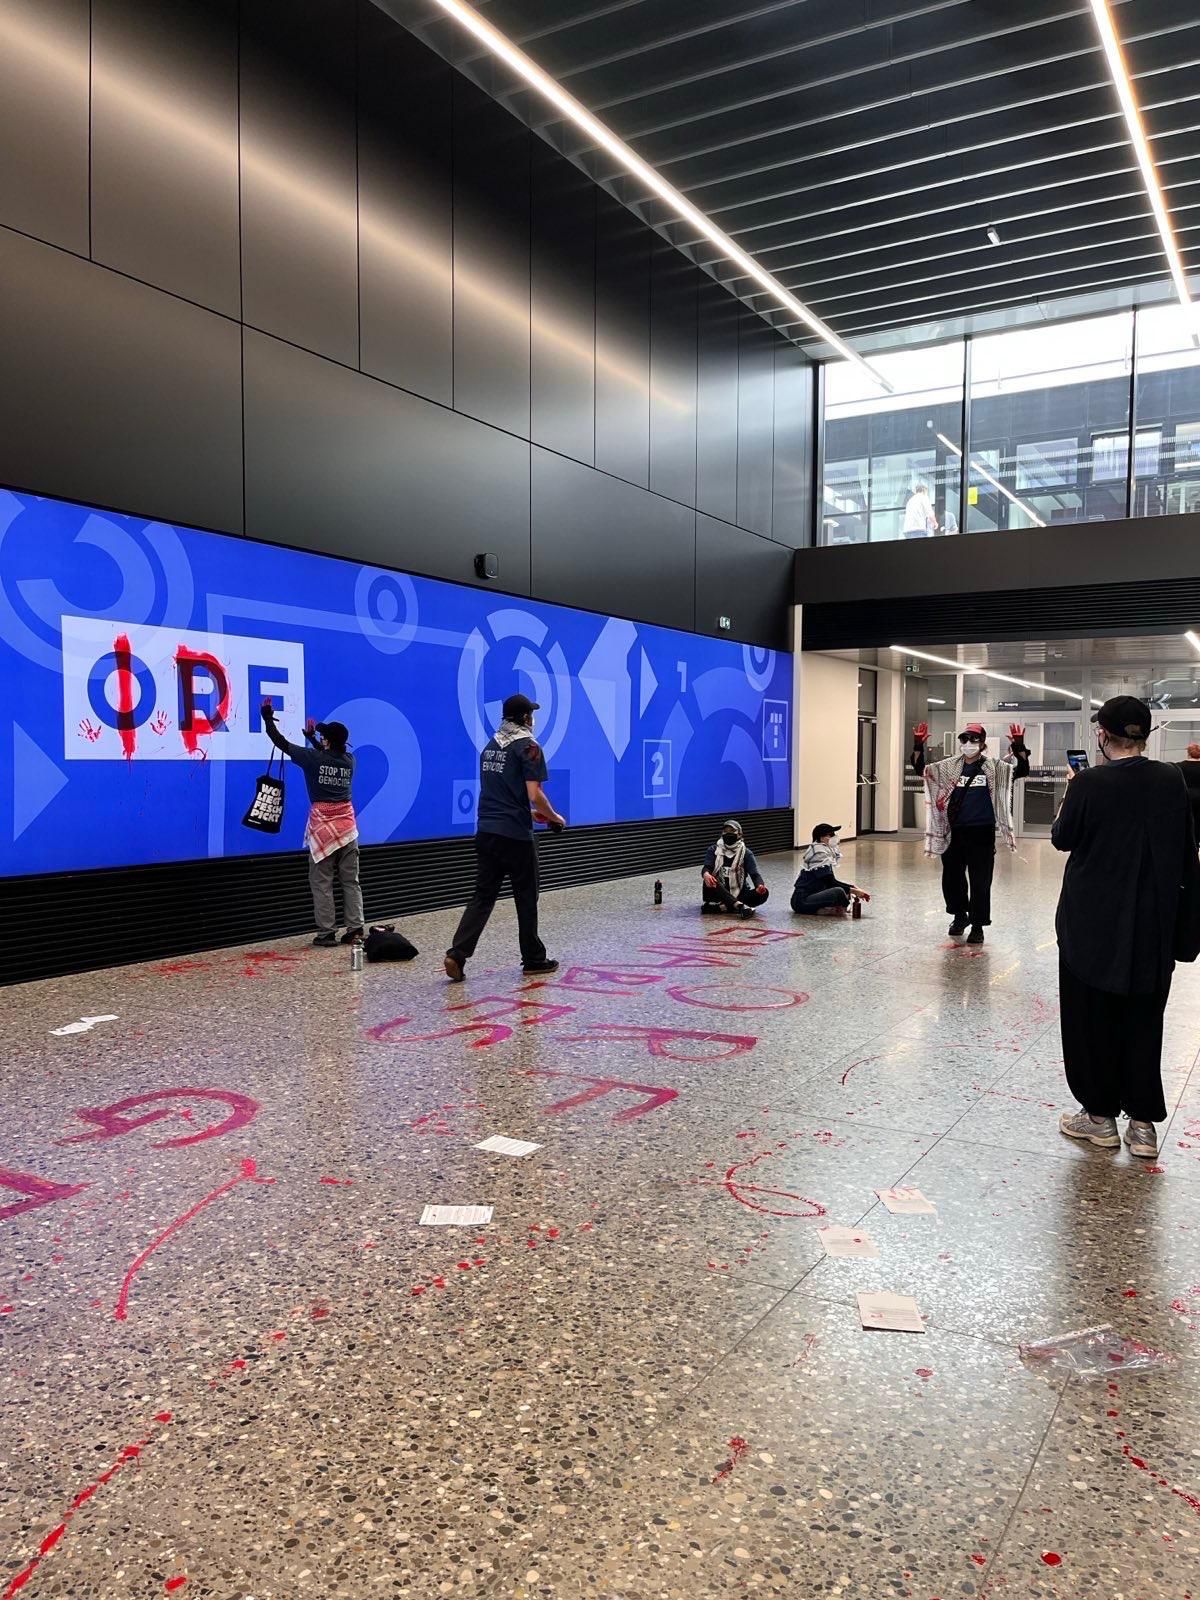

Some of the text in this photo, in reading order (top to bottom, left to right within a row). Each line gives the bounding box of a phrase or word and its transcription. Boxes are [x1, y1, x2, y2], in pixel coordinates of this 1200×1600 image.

[496, 751, 508, 762] THE
[319, 765, 352, 778] STOP THE
[250, 809, 280, 822] PICKT
